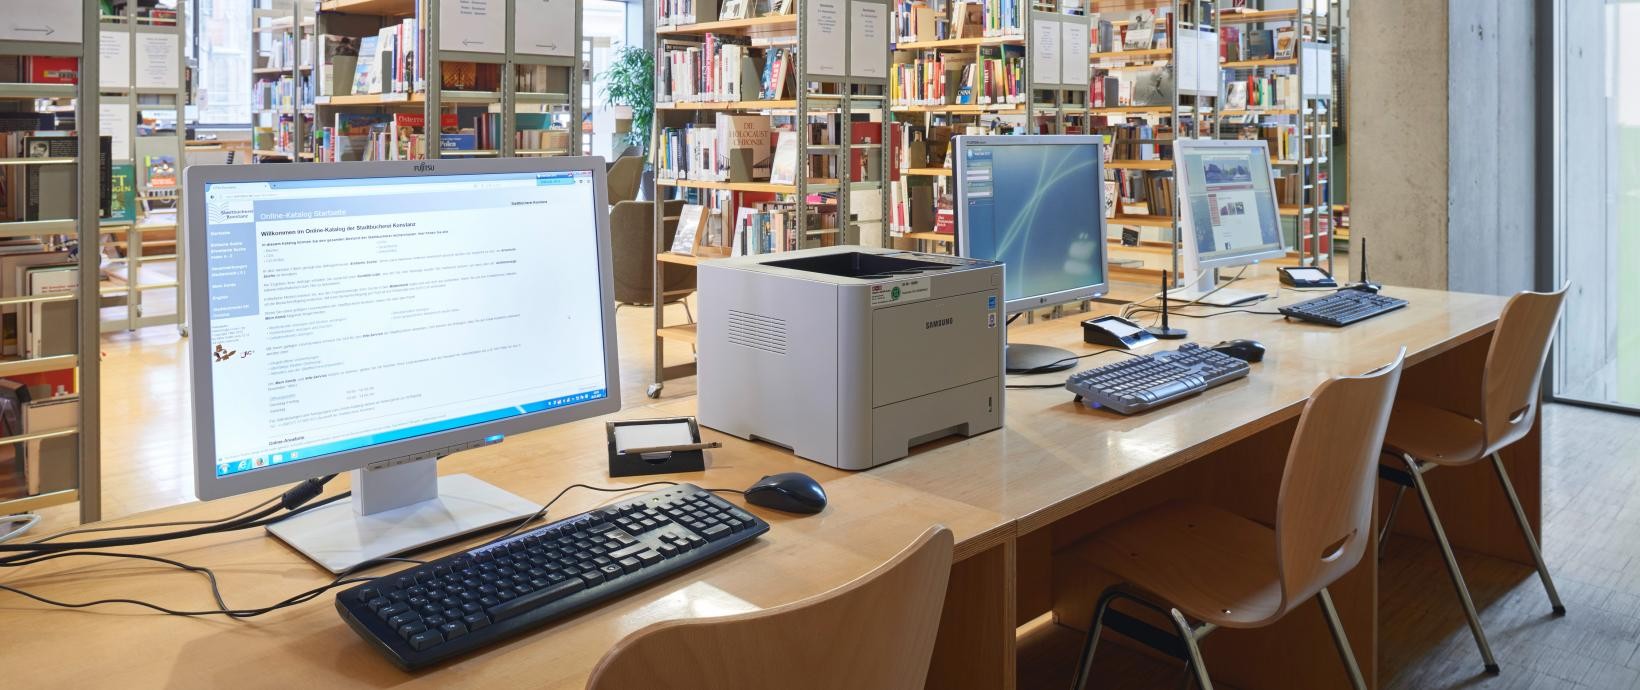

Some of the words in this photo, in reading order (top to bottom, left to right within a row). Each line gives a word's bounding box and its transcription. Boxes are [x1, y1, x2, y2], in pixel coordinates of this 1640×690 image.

[414, 162, 434, 172] FUJITSU
[261, 229, 296, 237] Willkommen
[306, 226, 345, 234] Online-Katalog
[925, 317, 953, 329] SAMSUNG
